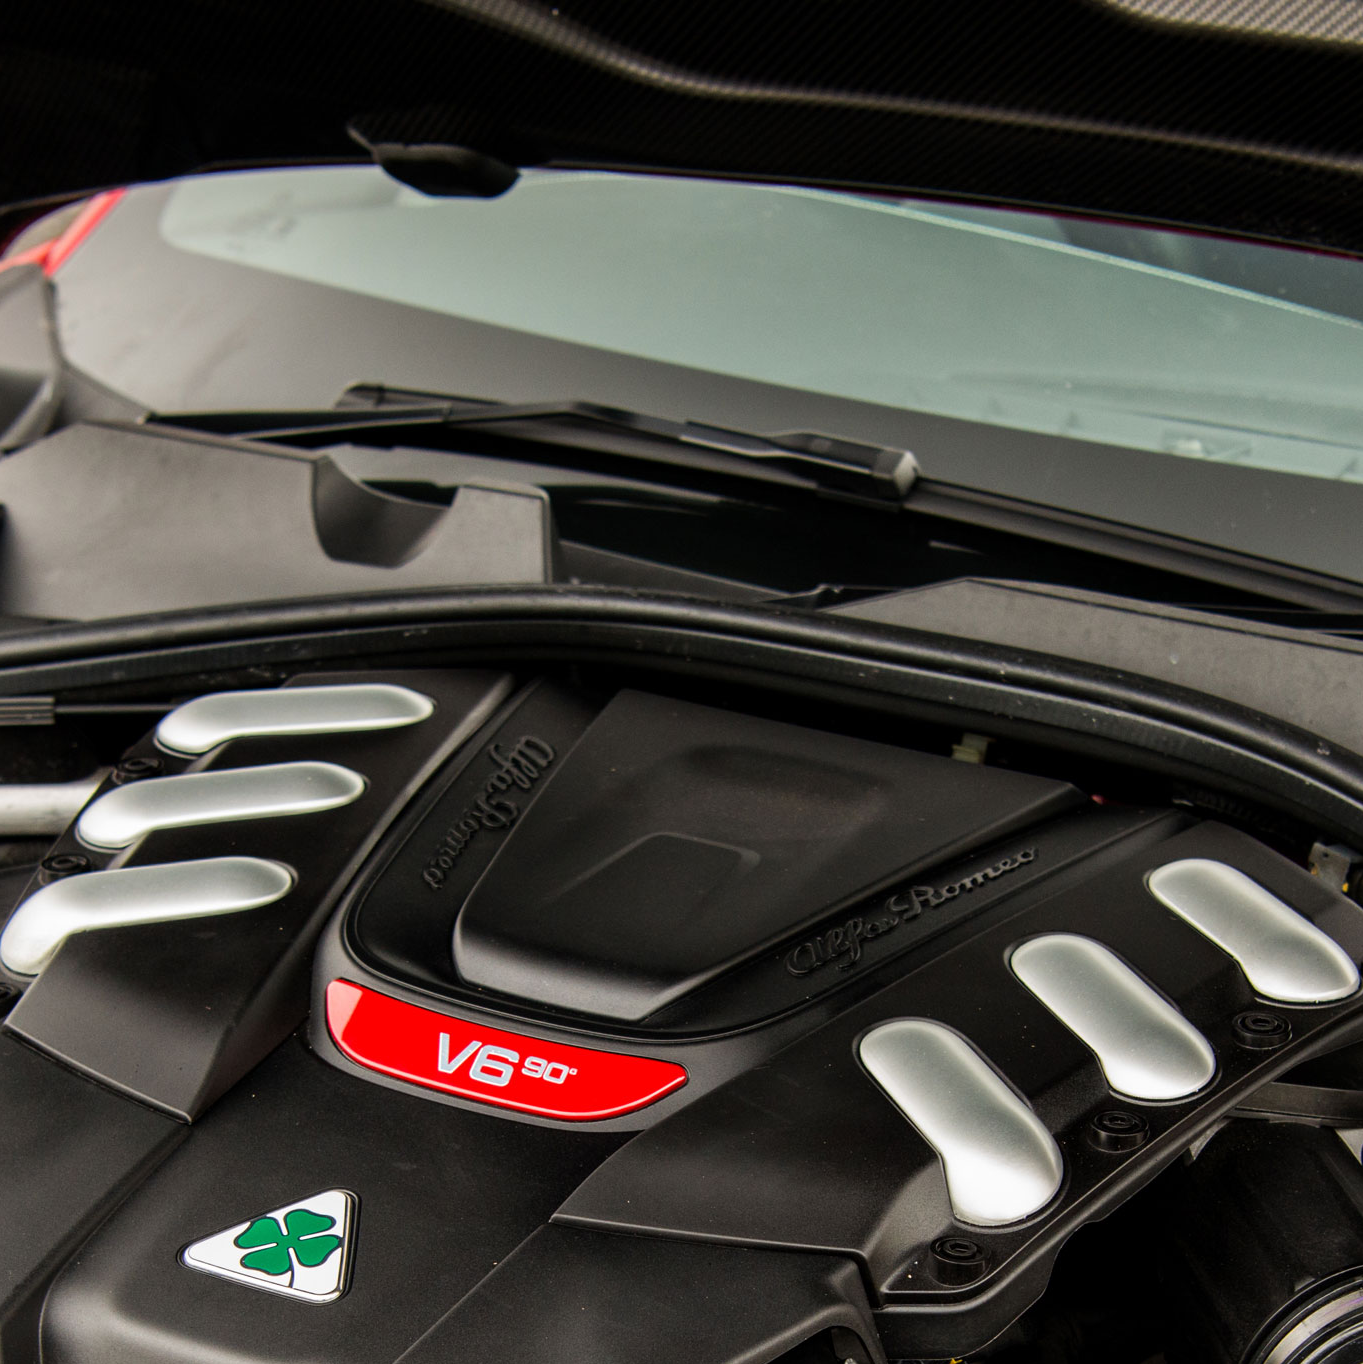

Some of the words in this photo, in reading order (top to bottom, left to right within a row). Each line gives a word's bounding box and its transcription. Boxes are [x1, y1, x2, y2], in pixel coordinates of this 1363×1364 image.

[488, 735, 555, 793] Alfa
[422, 793, 519, 889] Romeo
[785, 917, 899, 977] Alfa
[887, 848, 1036, 921] Romeo
[438, 1032, 520, 1087] V6
